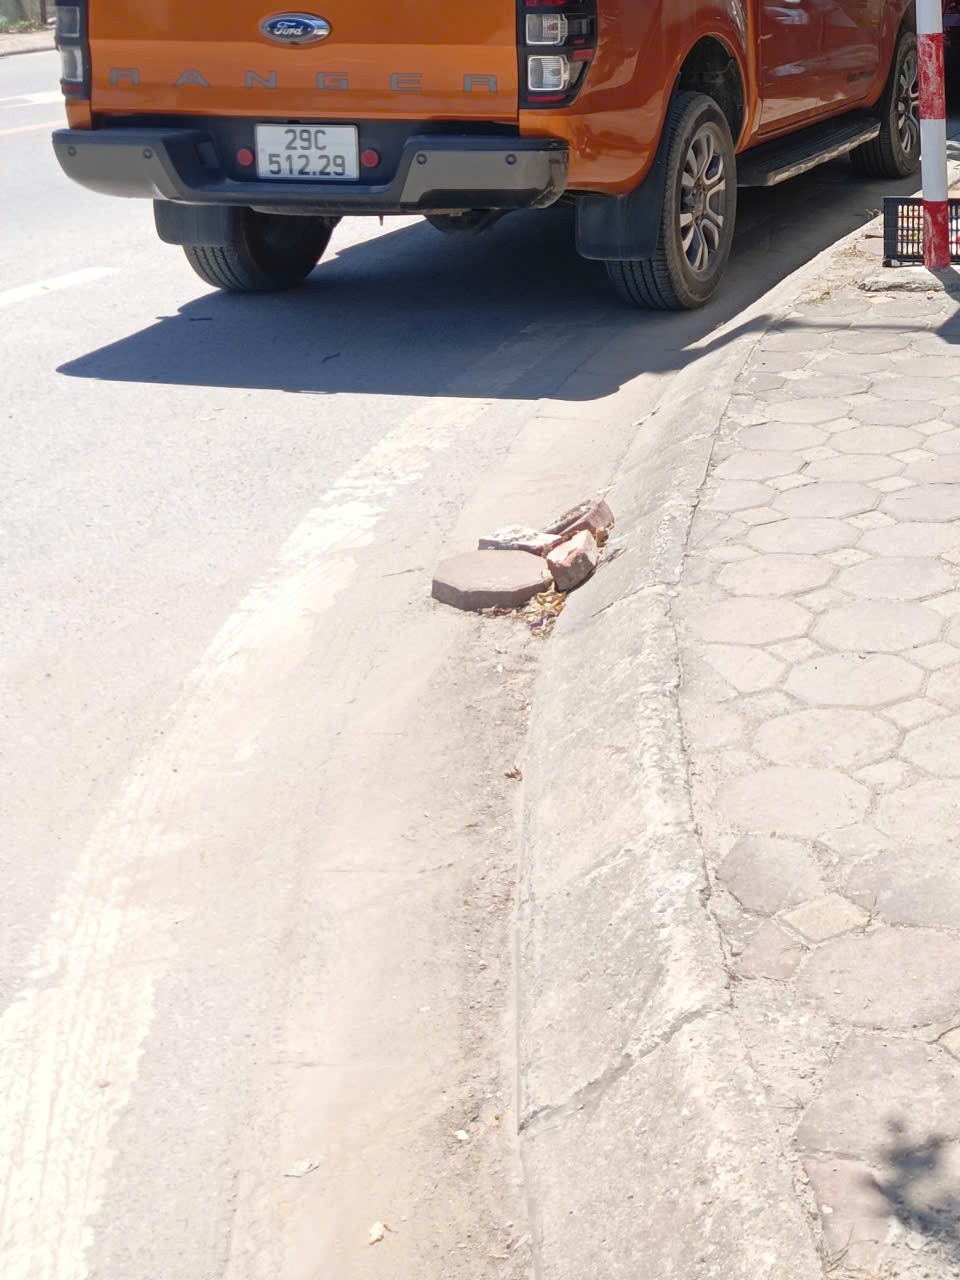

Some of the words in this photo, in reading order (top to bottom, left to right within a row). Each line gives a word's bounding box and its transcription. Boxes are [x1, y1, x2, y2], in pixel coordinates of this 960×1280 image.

[274, 21, 303, 36] Ford
[109, 67, 497, 93] RANGER
[284, 129, 327, 150] 29C
[268, 153, 346, 176] 512.29
